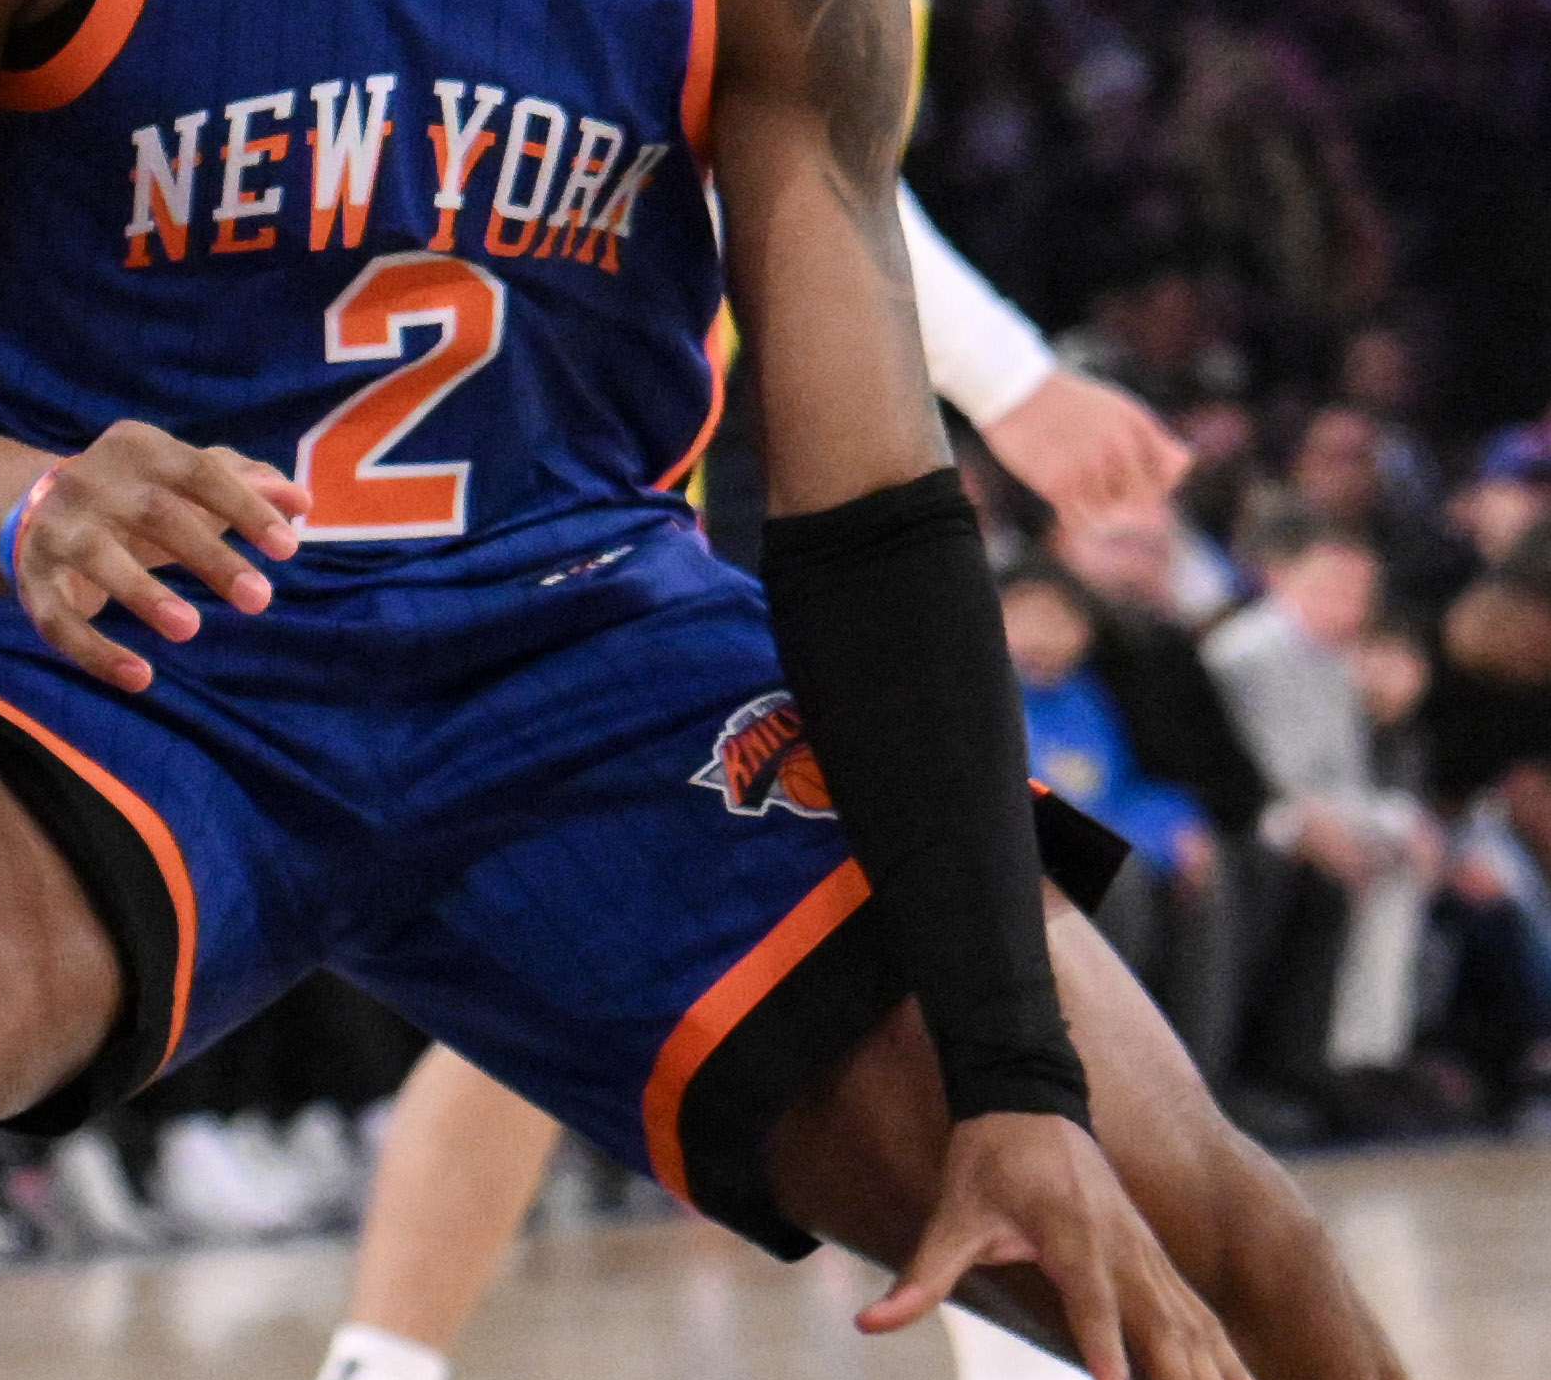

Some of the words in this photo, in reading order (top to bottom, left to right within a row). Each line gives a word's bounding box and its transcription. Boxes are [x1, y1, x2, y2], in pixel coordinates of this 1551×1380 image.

[125, 74, 397, 270] NEW
[427, 78, 669, 274] YORK
[294, 249, 504, 542] 2
